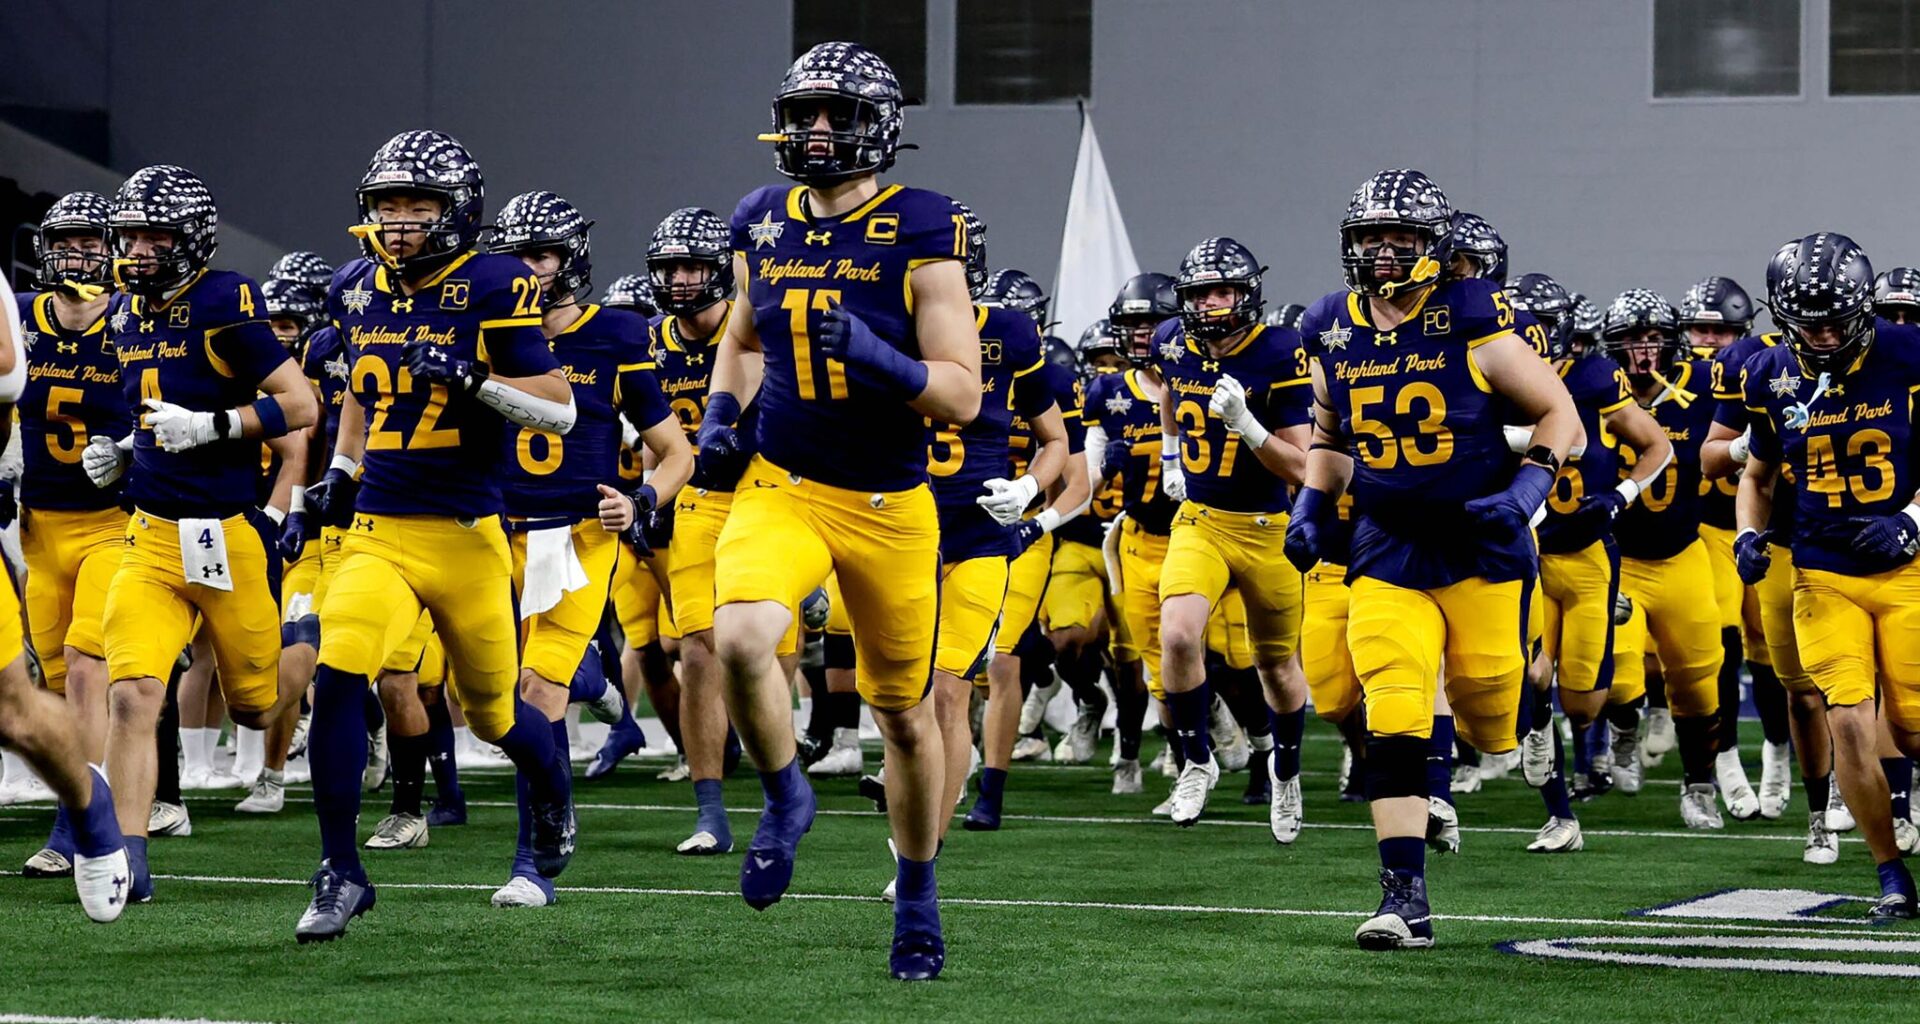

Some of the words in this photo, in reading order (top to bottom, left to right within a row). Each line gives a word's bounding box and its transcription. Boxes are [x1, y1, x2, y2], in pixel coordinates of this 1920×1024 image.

[505, 233, 531, 243] Riddell
[866, 217, 898, 239] C
[759, 257, 832, 286] Highland
[833, 259, 881, 281] Park
[239, 283, 255, 318] 4
[440, 284, 469, 305] PC
[512, 274, 542, 318] 22
[170, 306, 189, 324] PC
[1424, 310, 1449, 332] PC
[1801, 309, 1829, 317] Riddell
[350, 325, 412, 351] Highland
[416, 325, 456, 345] Park
[780, 288, 849, 400] 11
[117, 343, 156, 368] Highland
[157, 340, 188, 360] Park
[27, 360, 79, 382] ighland
[81, 365, 119, 384] Park
[1335, 357, 1400, 385] Highland
[1405, 352, 1446, 373] Park
[661, 374, 709, 397] Highland
[351, 354, 460, 450] 22
[1854, 399, 1893, 421] Park
[46, 386, 88, 464] 5
[1175, 400, 1241, 477] 37
[1349, 382, 1454, 469] 53
[1806, 428, 1896, 508] 43
[198, 527, 214, 549] 4
